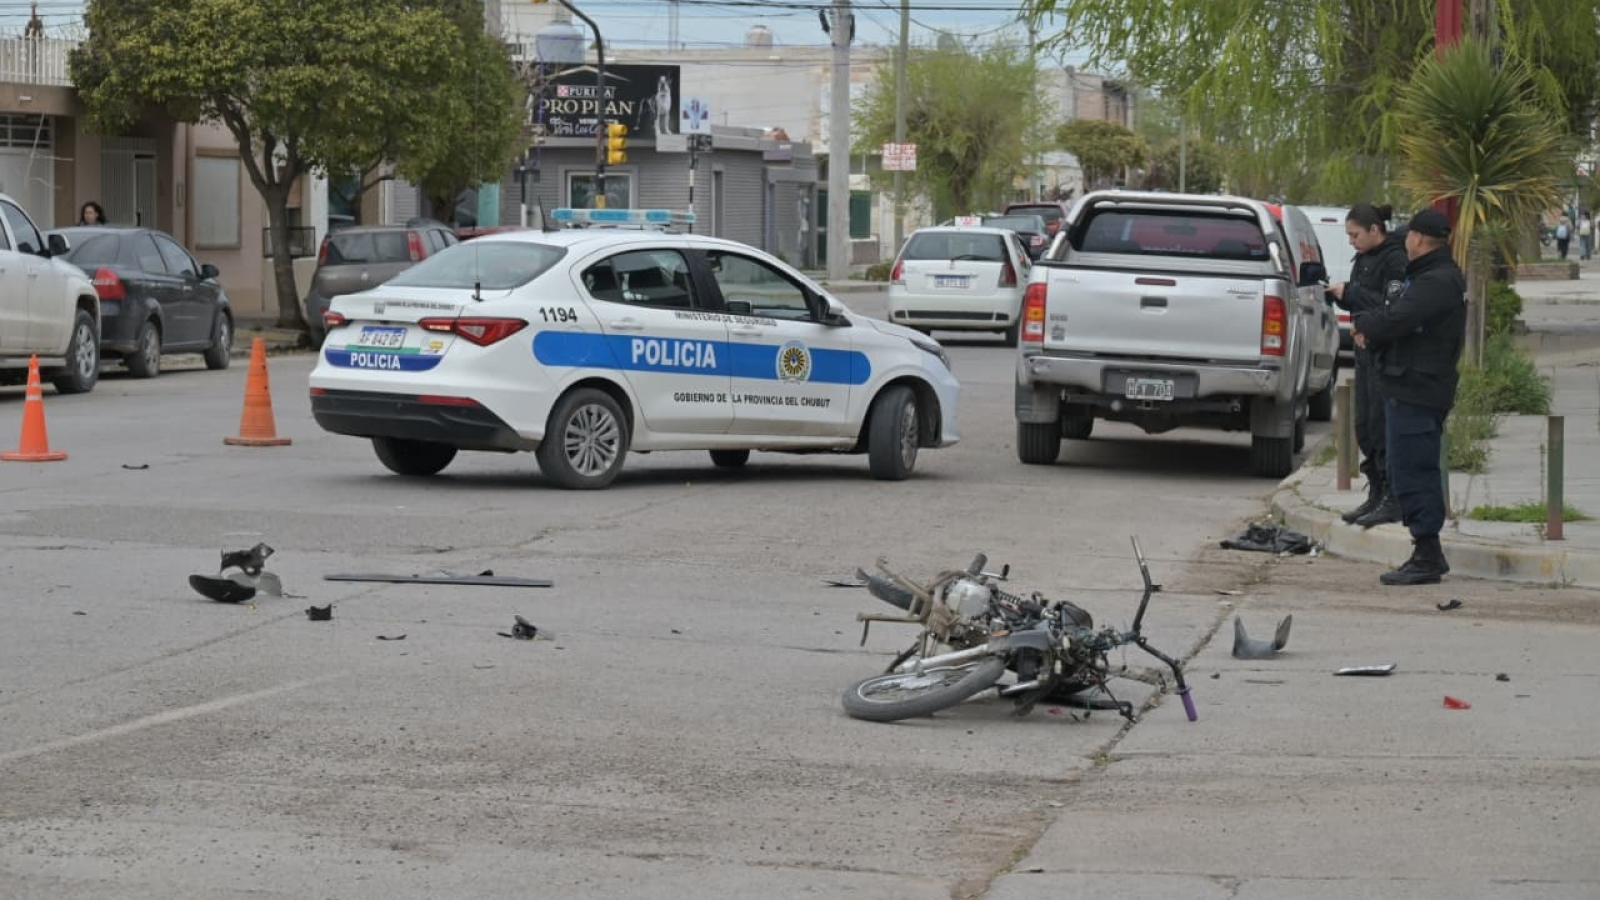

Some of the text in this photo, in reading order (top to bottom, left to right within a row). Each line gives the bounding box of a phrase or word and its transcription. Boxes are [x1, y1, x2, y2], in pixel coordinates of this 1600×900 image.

[569, 87, 612, 97] PURIA
[539, 306, 578, 323] 1194
[675, 311, 720, 322] MINISTERIO
[349, 352, 401, 370] POLICIA
[631, 338, 717, 368] POLICIA
[673, 392, 831, 408] GOBIERNO DE LA PROVINCIA DEL CHUBUT
